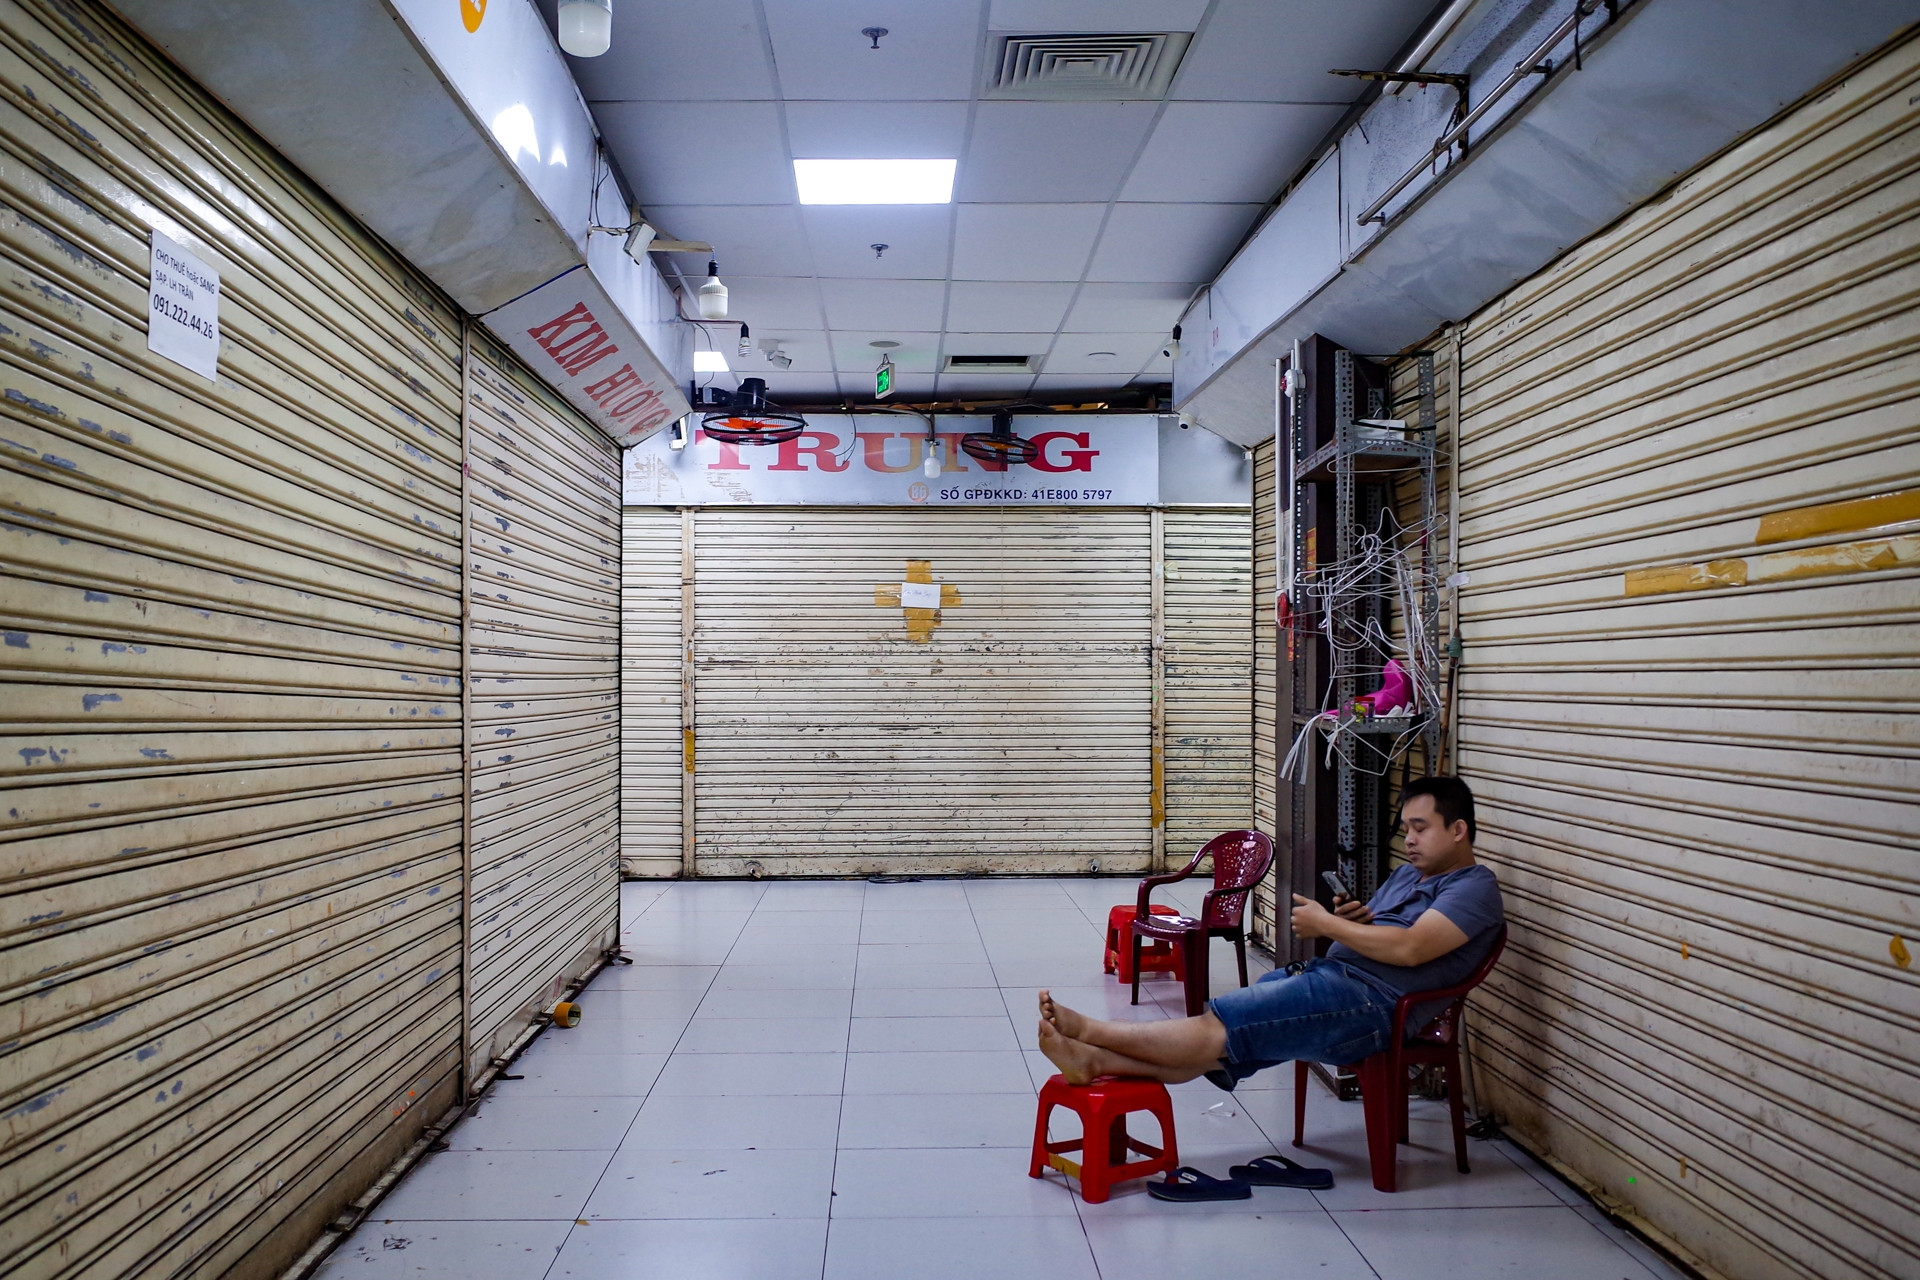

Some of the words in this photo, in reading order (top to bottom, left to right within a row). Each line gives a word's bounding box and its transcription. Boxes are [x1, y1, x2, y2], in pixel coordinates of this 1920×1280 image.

[155, 248, 169, 265] CHO
[170, 256, 185, 276] THUÊ
[199, 276, 215, 295] SANG
[169, 277, 177, 292] LH
[153, 293, 213, 340] 091.222.44.26
[526, 301, 619, 378] KIM
[694, 429, 1100, 473] TRUNG
[940, 485, 959, 500] SỐ
[964, 489, 1027, 500] GPĐKKD:
